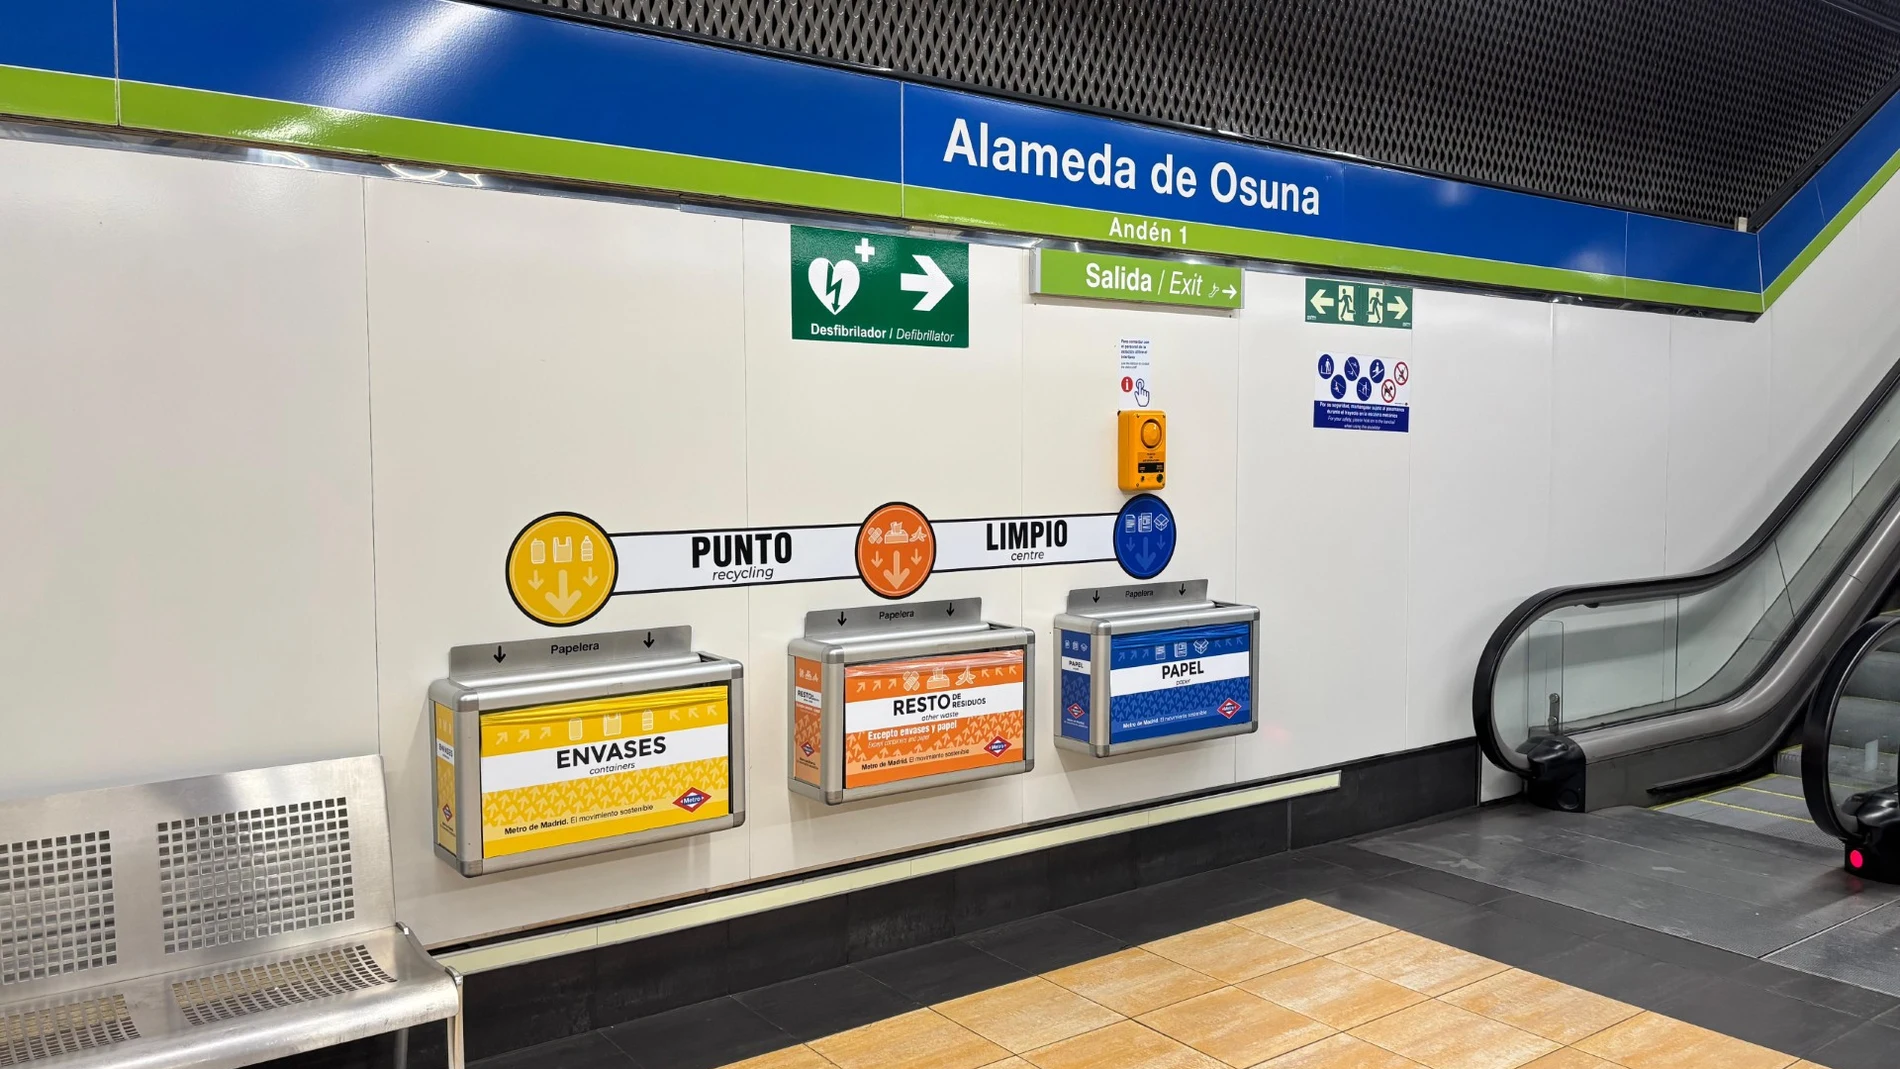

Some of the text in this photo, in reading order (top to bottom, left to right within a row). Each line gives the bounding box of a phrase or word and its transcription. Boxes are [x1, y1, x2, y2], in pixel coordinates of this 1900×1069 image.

[942, 117, 1320, 215] Alameda de Osuna
[1109, 216, 1188, 244] Andén 1
[1085, 262, 1203, 297] Salida / Exit
[810, 322, 955, 342] Desfibrilador / Defibrillator
[986, 519, 1068, 551] LIMPIO
[692, 532, 792, 568] PUNTO
[1010, 549, 1045, 562] centre
[712, 565, 774, 583] recycling
[1125, 590, 1154, 599] Papelera
[879, 609, 915, 621] Papelera
[550, 641, 600, 655] Papelera
[1069, 660, 1084, 668] PAPEL
[1161, 660, 1204, 680] PAPEL
[893, 692, 962, 716] RESTO DE
[952, 697, 986, 709] RESIDUOS
[921, 710, 959, 722] other waste
[868, 720, 957, 741] Excepto envases y papel
[556, 735, 667, 769] ENVASES
[915, 752, 944, 762] movimiento
[945, 748, 970, 758] sostenible
[588, 761, 636, 776] containers
[682, 794, 702, 804] Metro
[504, 826, 528, 835] Metro
[540, 818, 569, 829] Madrid.
[570, 816, 578, 824] El
[579, 810, 618, 822] movimiento
[620, 804, 654, 816] sostenible
